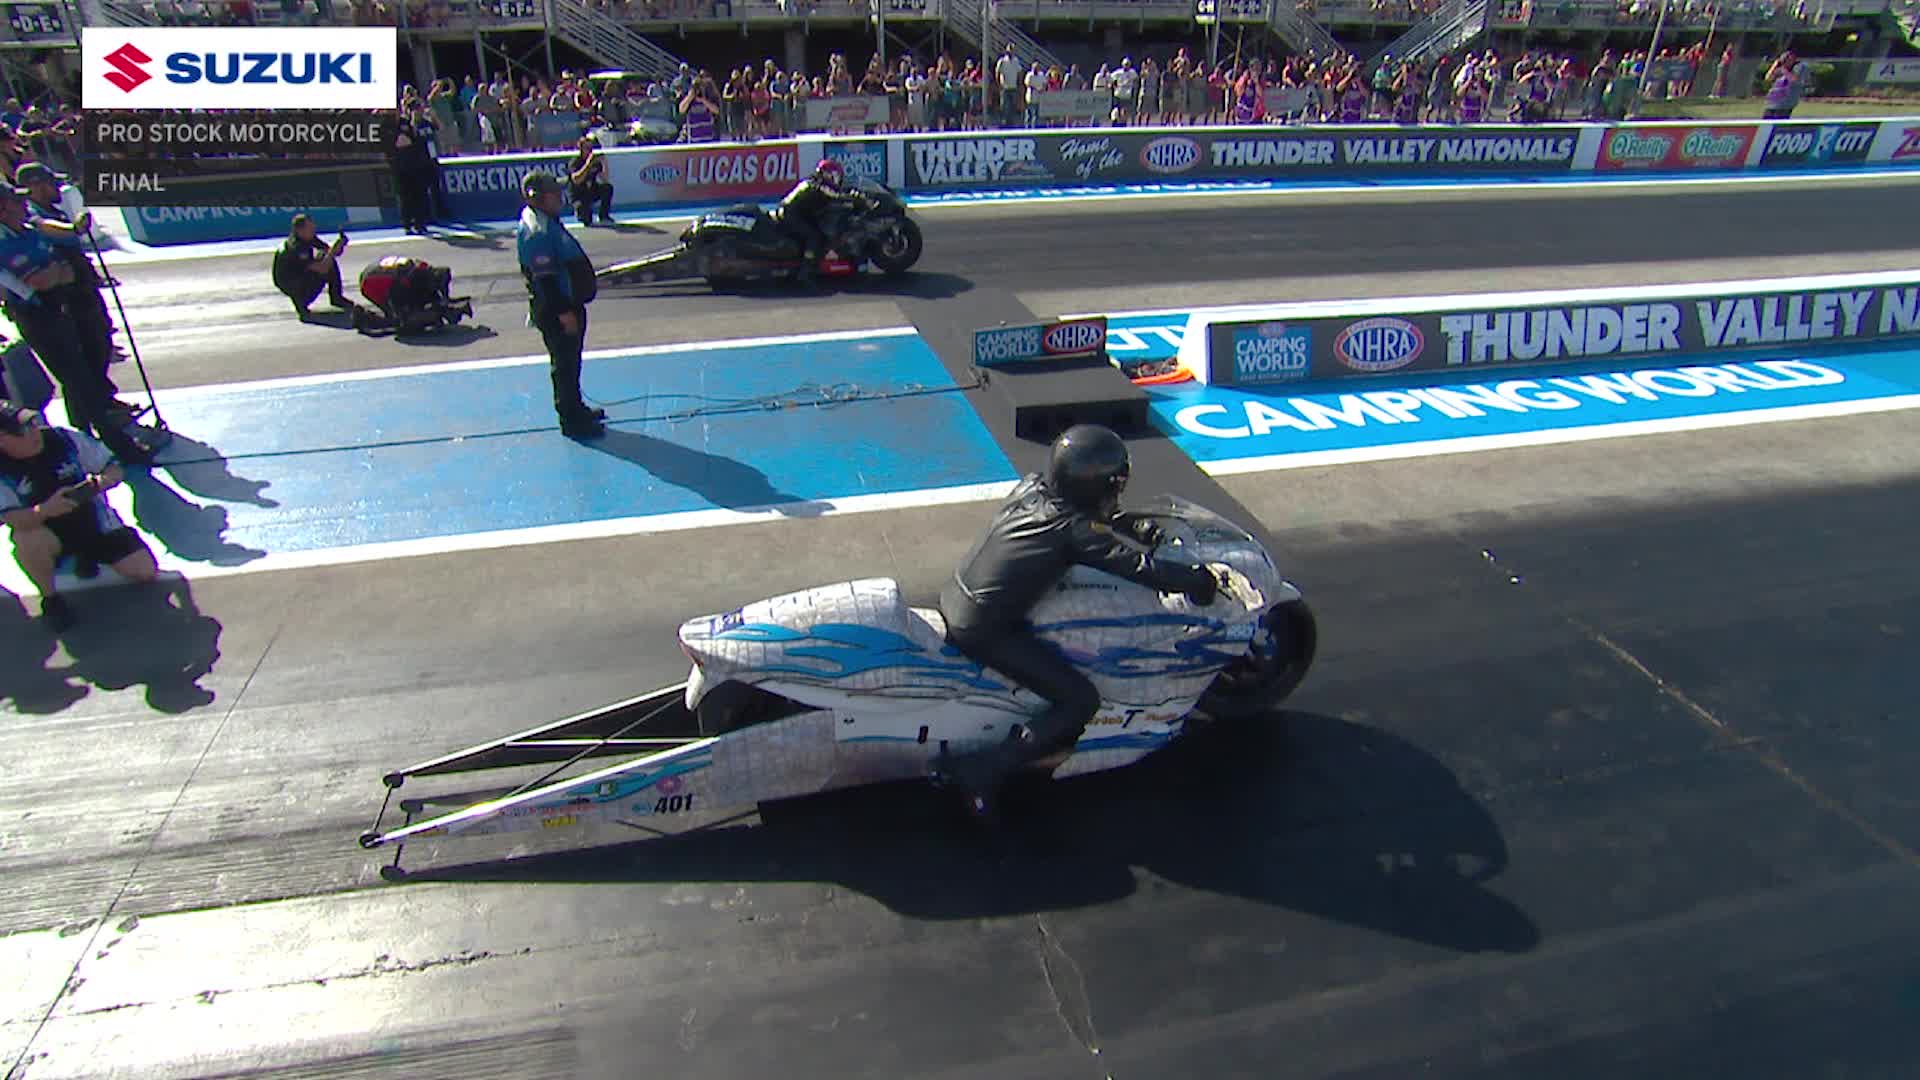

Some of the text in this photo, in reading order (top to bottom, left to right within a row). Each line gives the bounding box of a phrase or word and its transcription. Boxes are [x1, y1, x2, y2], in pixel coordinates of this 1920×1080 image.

[911, 139, 1036, 162] THUNDER
[1060, 137, 1110, 161] Home
[1211, 137, 1575, 167] THUNDER VALLEY NATIONALS
[1768, 132, 1814, 154] FOOD
[1833, 130, 1874, 151] CITY
[1075, 161, 1096, 179] of
[1099, 151, 1124, 170] the
[1150, 143, 1194, 166] NHRA
[685, 151, 797, 185] LUCAS OIL
[916, 160, 1004, 184] VALLEY
[976, 328, 1039, 346] CAMPING
[1051, 326, 1098, 350] NHRA
[1441, 302, 1681, 364] THUNDER
[1696, 291, 1873, 347] VALLEY
[978, 341, 1038, 361] WORLD
[1236, 336, 1306, 354] CAMPING
[1350, 328, 1411, 361] NHRA
[1237, 351, 1306, 372] WORLD
[1175, 359, 1845, 438] CAMPING WORLD
[654, 793, 693, 814] 401
